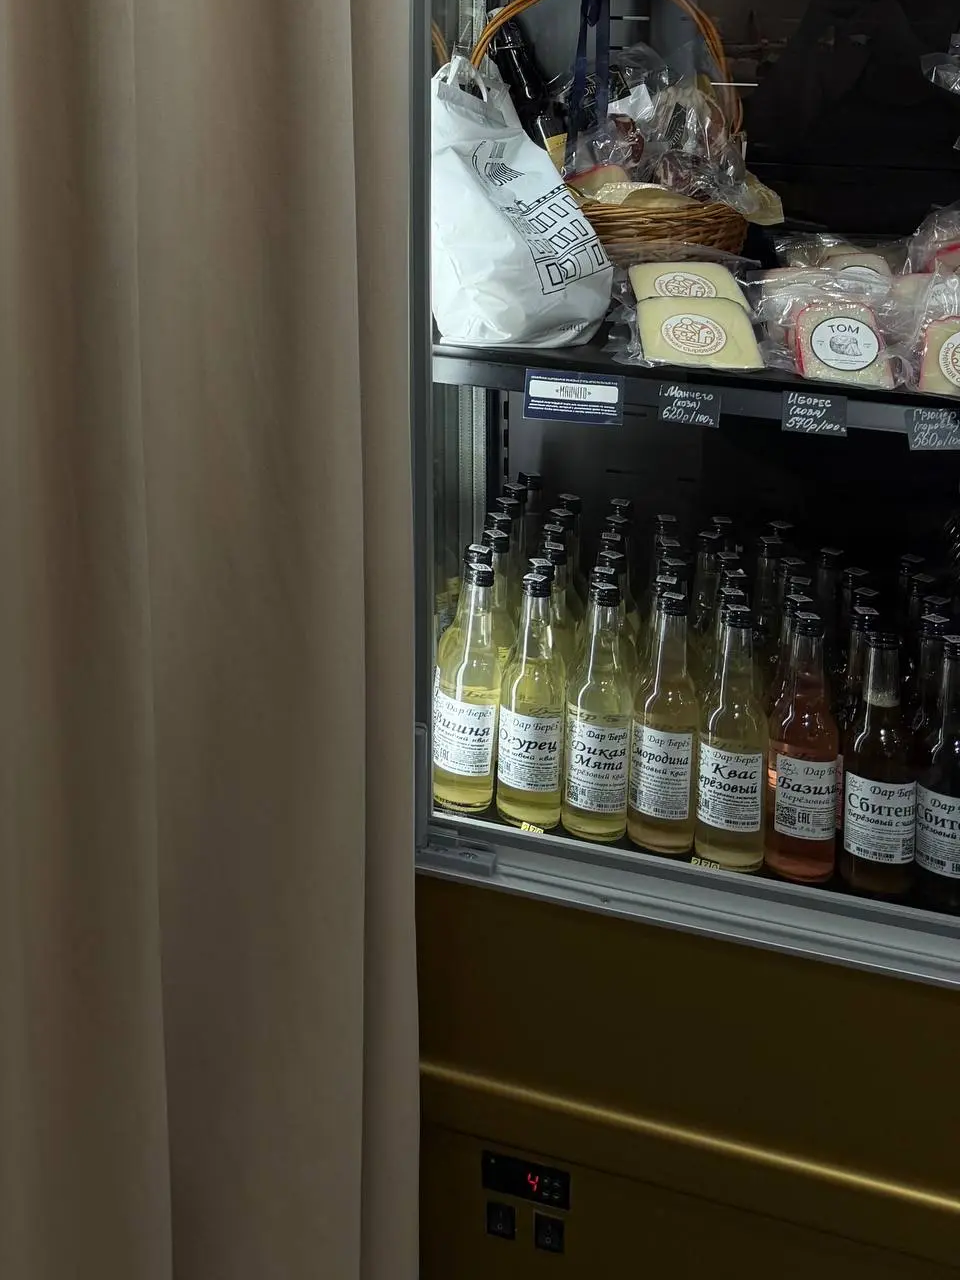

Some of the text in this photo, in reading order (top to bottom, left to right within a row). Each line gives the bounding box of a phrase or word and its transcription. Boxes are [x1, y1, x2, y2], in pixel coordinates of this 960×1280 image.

[827, 323, 860, 335] ТОМ
[500, 727, 557, 753] Огурец
[586, 730, 606, 742] Дар
[647, 734, 665, 747] Дар
[571, 740, 626, 760] Дикая
[712, 751, 732, 764] Дар
[574, 754, 623, 771] Мята
[711, 763, 757, 780] Квас
[803, 766, 826, 779] Дар
[699, 773, 758, 794] ерёзовый
[870, 785, 895, 800] Дар
[930, 798, 956, 814] Дар
[917, 803, 960, 831] Сбит
